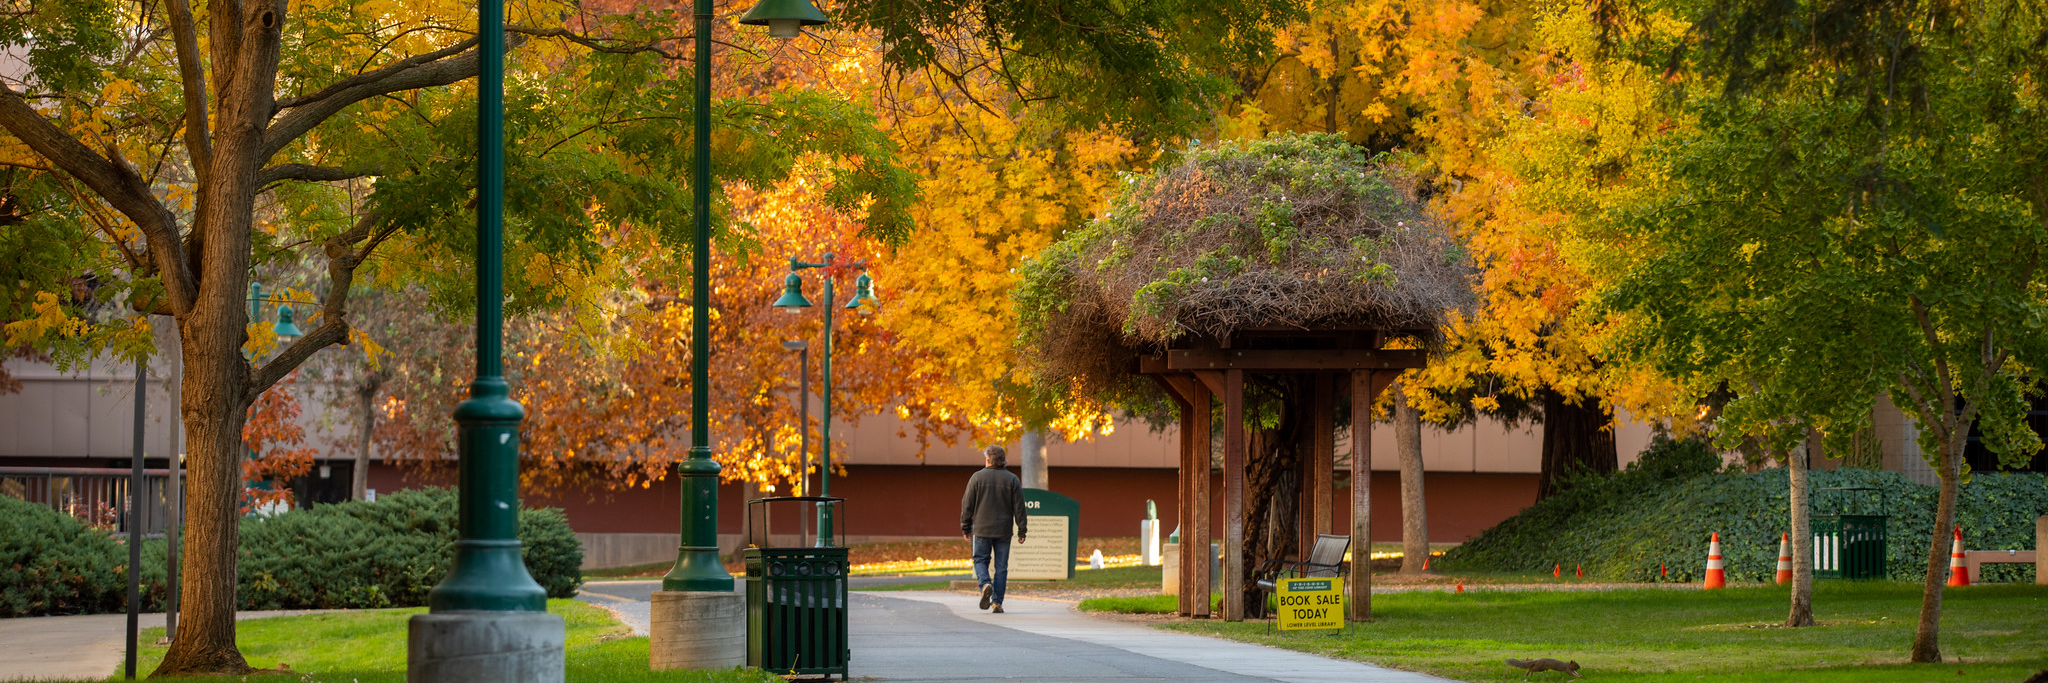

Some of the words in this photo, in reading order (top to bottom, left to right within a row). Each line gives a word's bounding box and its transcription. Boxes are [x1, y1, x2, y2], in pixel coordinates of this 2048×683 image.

[1281, 596, 1310, 606] BOOK
[1317, 595, 1340, 604] SALE
[1293, 608, 1328, 619] TODAY
